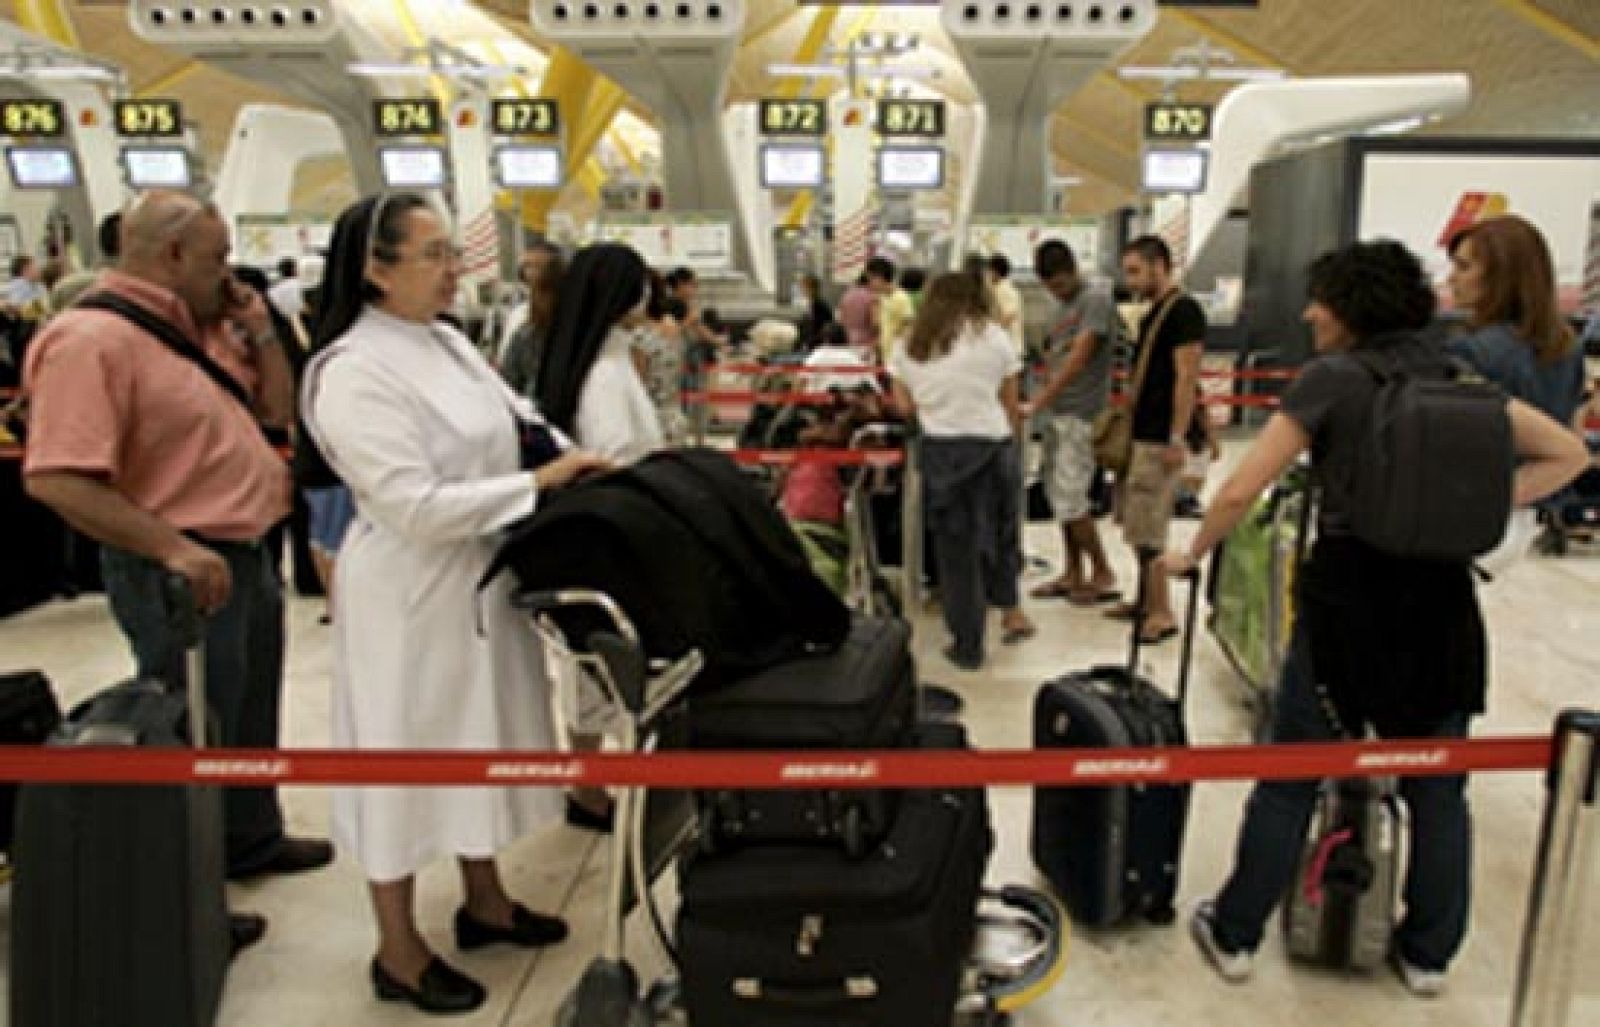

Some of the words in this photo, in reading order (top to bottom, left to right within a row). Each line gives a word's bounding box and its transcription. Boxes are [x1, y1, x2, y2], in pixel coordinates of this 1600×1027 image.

[4, 103, 58, 131] 876
[121, 103, 174, 131] 875
[380, 103, 433, 130] 874
[497, 103, 550, 130] 873
[767, 103, 819, 129] 872
[886, 103, 935, 131] 871
[1152, 107, 1205, 135] 870
